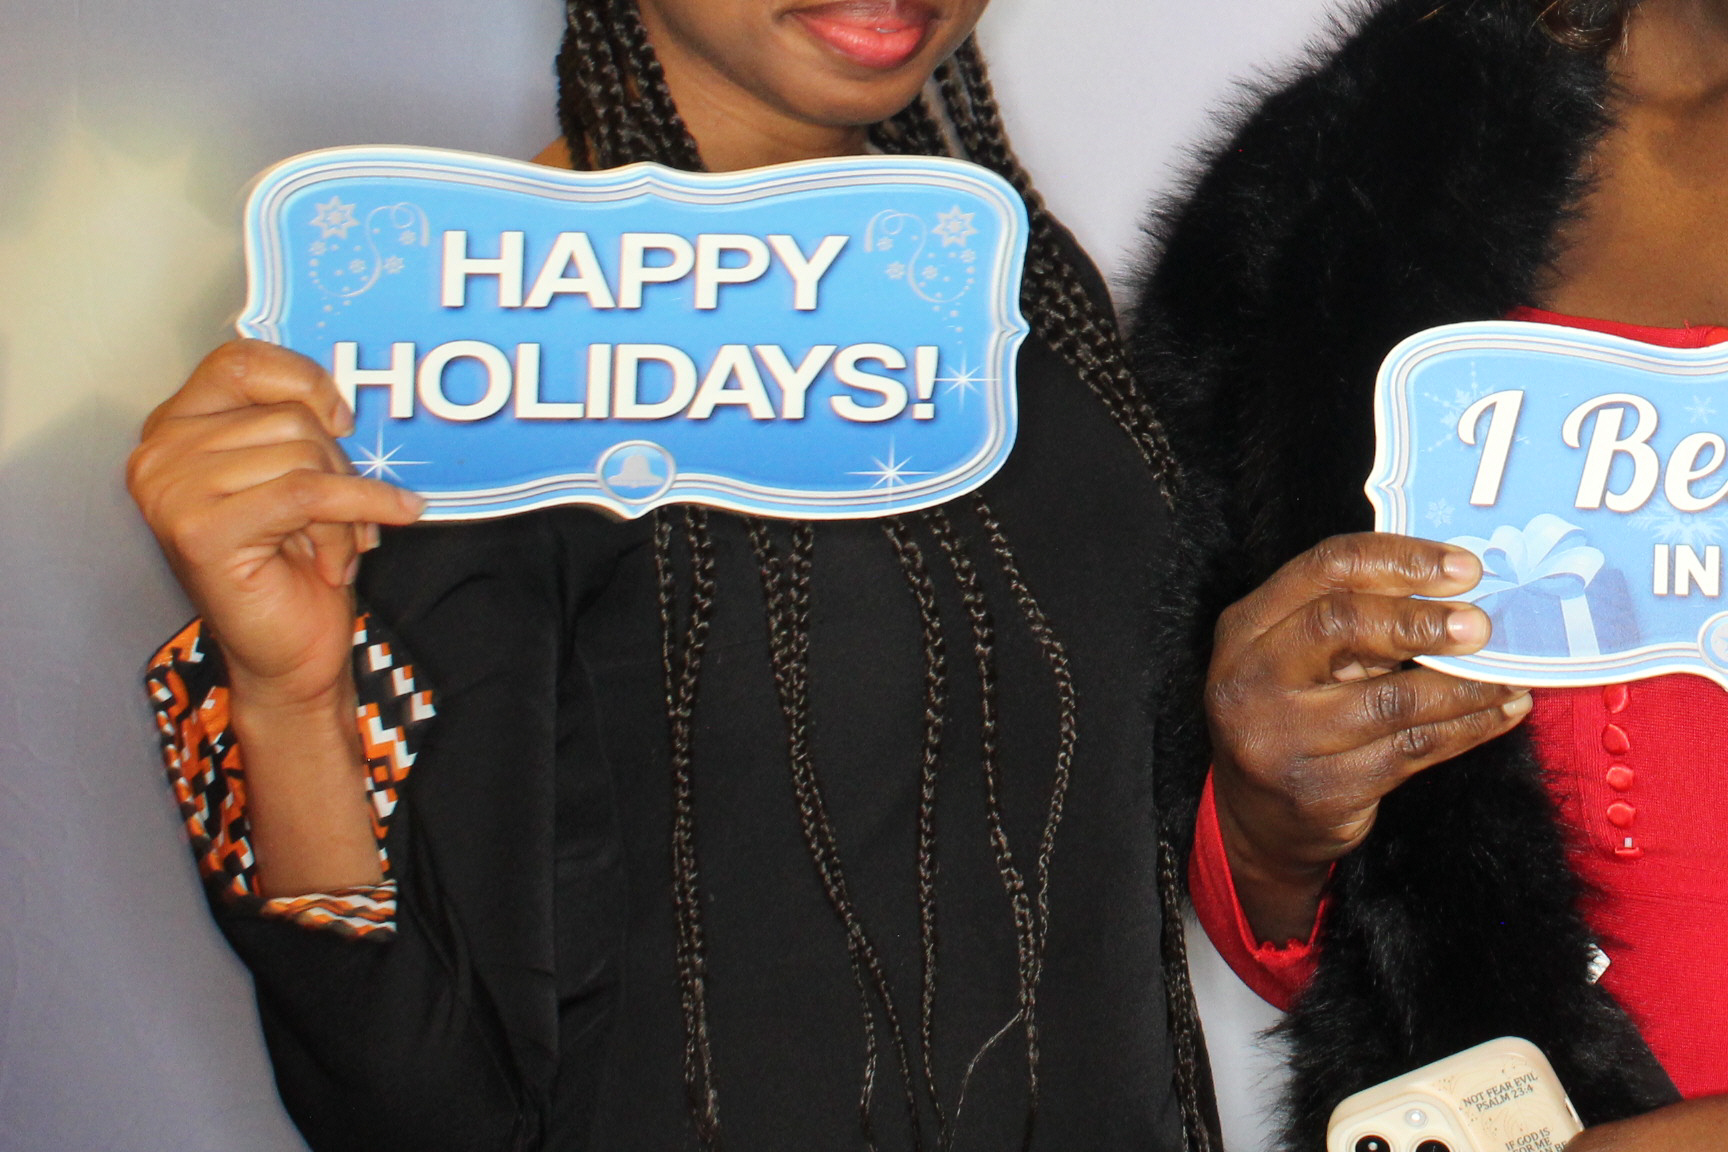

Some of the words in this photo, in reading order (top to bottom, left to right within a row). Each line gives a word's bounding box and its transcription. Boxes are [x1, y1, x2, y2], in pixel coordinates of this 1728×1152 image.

[441, 229, 851, 312] HAPPY
[334, 341, 939, 422] HOLIDAYS!
[1457, 390, 1524, 506] I
[1652, 544, 1720, 597] IN
[1463, 1092, 1485, 1107] NOT
[1486, 1081, 1513, 1099] FEAR
[1513, 1073, 1538, 1087] EVIL
[1476, 1094, 1511, 1112] PSALM
[1511, 1084, 1533, 1098] 23:4
[1505, 1140, 1515, 1151] IF
[1517, 1132, 1538, 1146] GOD
[1539, 1127, 1550, 1137] IS
[1534, 1137, 1552, 1150] ME
